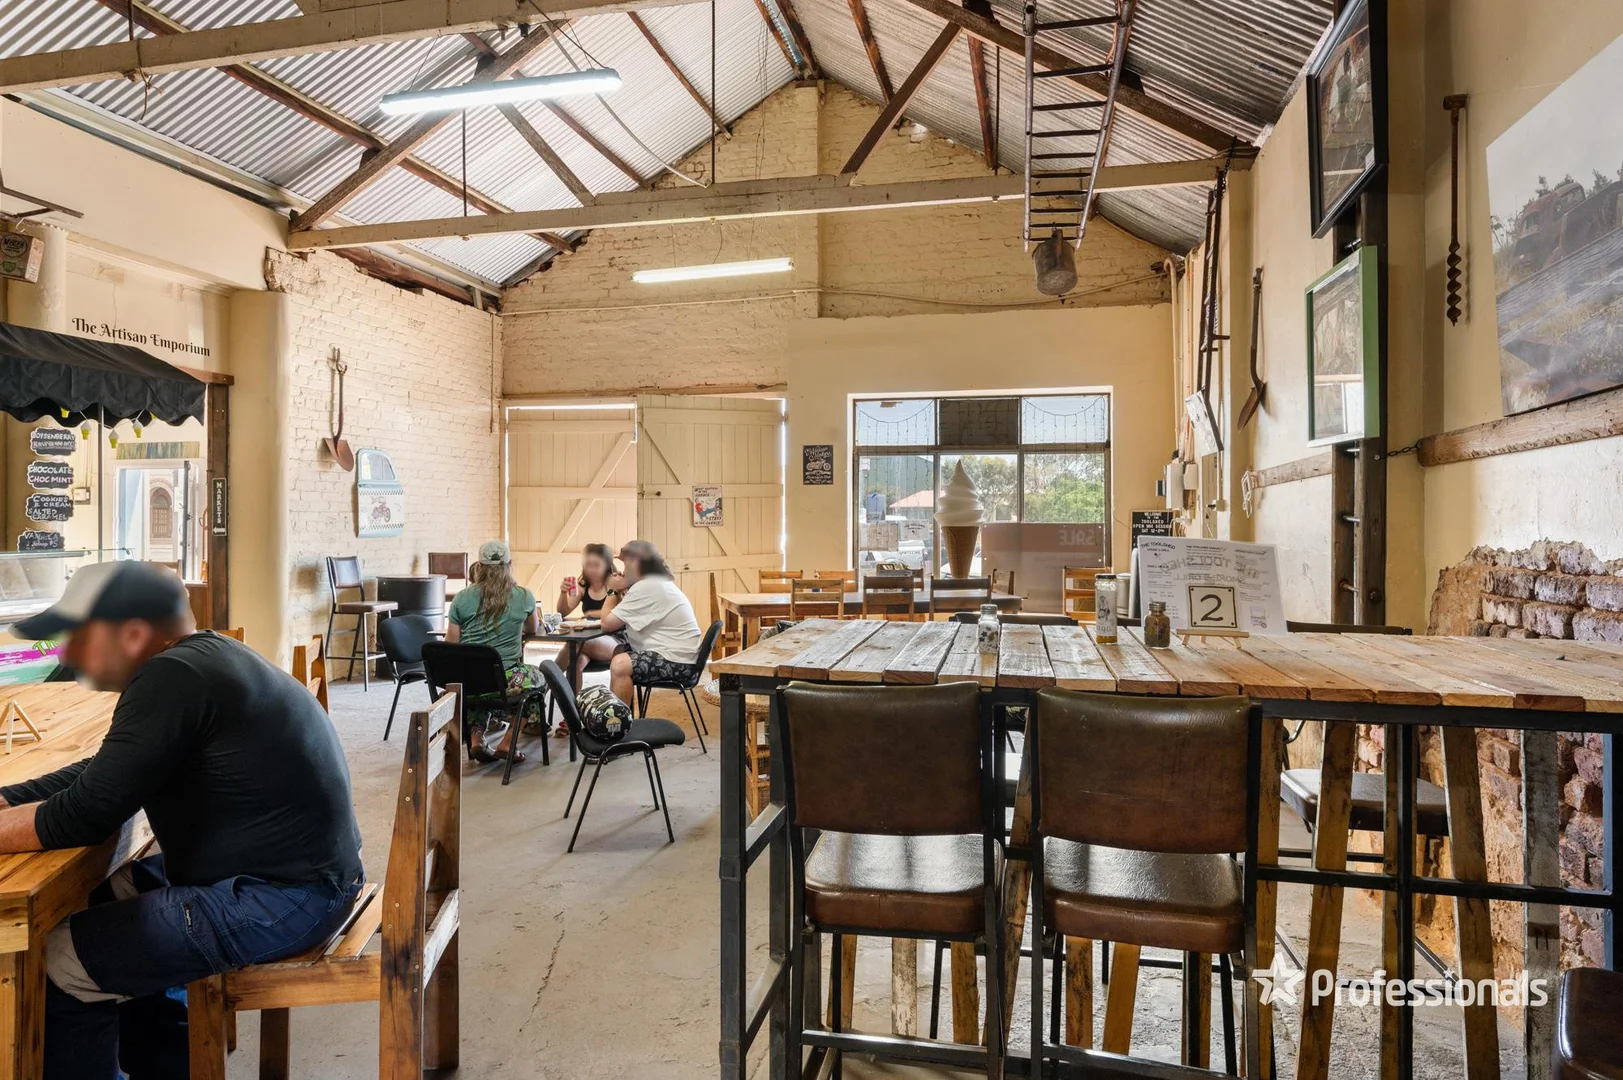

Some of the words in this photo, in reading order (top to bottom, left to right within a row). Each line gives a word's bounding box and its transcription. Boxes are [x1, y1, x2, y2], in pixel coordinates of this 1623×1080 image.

[72, 317, 97, 335] The
[99, 323, 147, 345] Artisan
[150, 334, 210, 357] Emporium
[29, 466, 73, 474] CHOCOLATE
[29, 475, 50, 483] CHOC
[51, 476, 73, 484] MINT
[1151, 541, 1176, 550] TOOLSHED
[1200, 594, 1224, 622] 2
